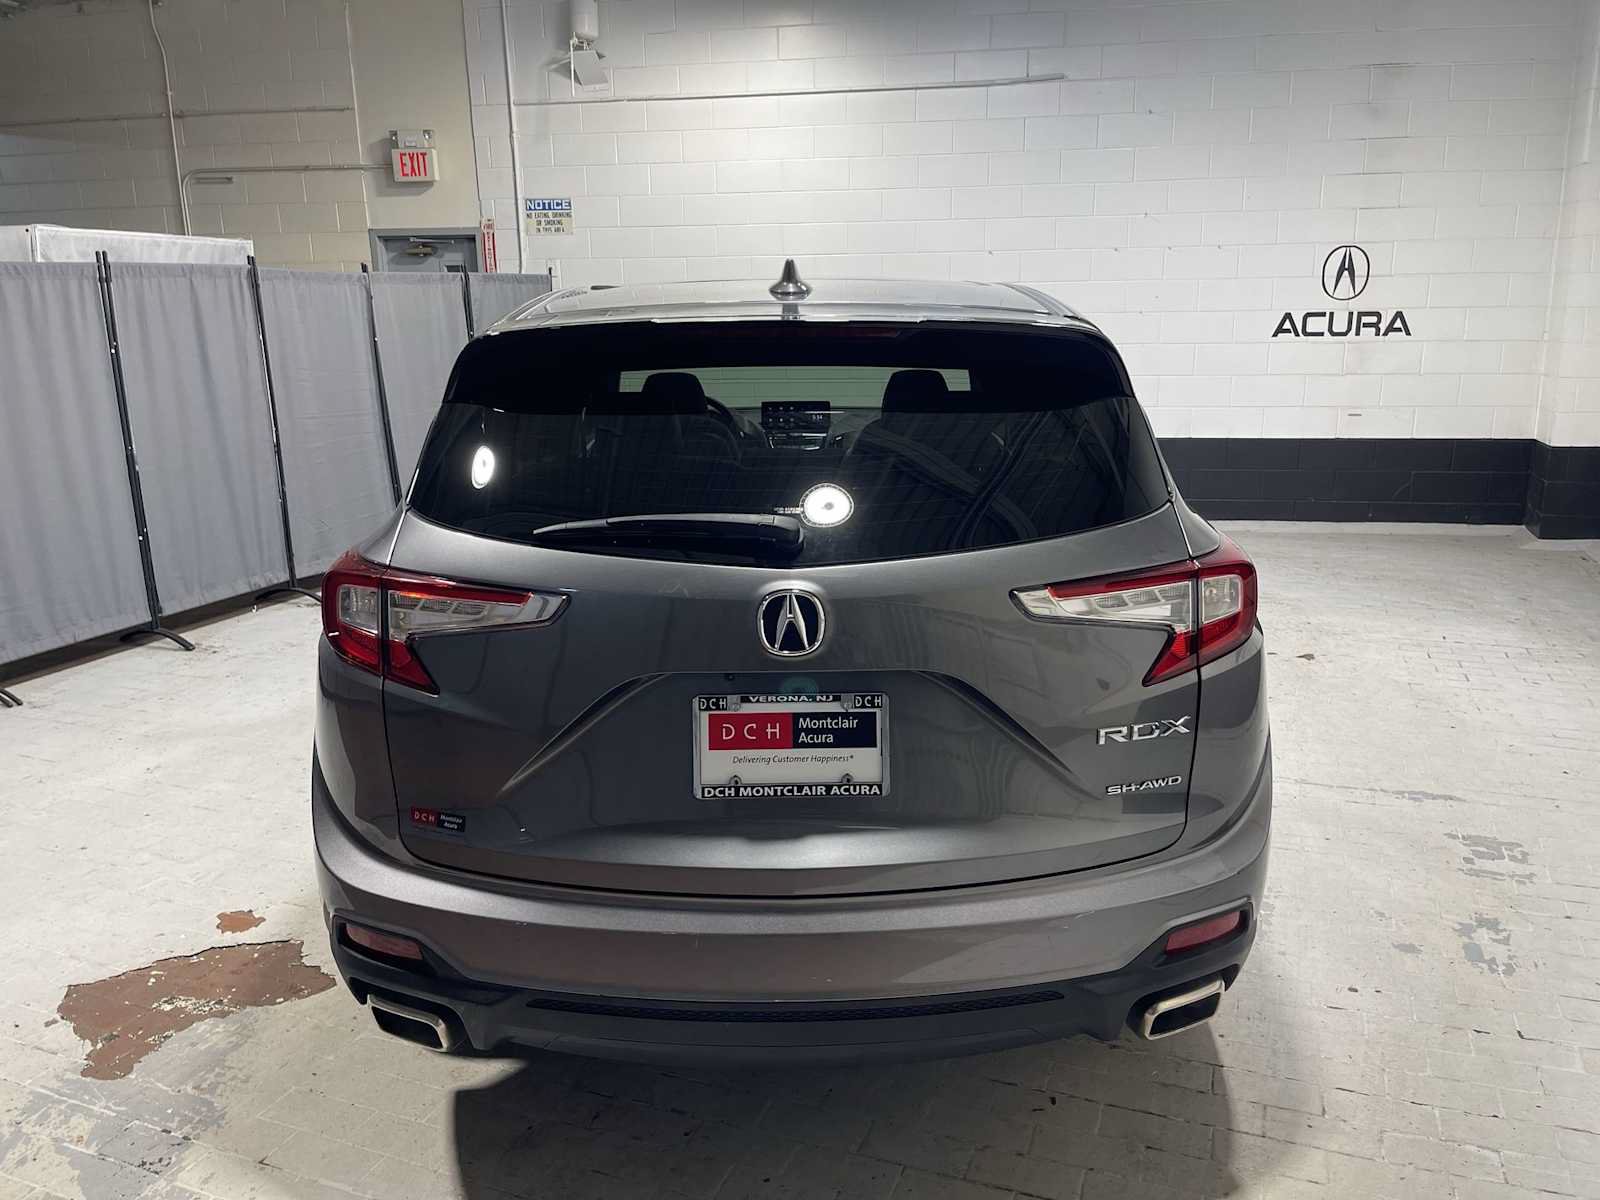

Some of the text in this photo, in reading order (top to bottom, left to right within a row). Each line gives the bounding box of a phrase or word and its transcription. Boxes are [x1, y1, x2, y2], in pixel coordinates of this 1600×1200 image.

[400, 152, 428, 177] EXIT
[526, 199, 571, 210] NOTICE
[1272, 310, 1412, 338] ACURA
[700, 698, 727, 709] DCH
[816, 695, 833, 703] NJ
[855, 695, 882, 707] DCH
[799, 716, 858, 729] Montclair
[722, 723, 780, 740] DCH
[1097, 716, 1191, 745] RDX
[799, 732, 834, 743] Acura
[732, 756, 771, 765] Delivering
[772, 755, 809, 764] Customer
[704, 784, 881, 797] DCH MONTCLAIR ACURA
[1106, 776, 1182, 795] SH-AWD
[414, 810, 435, 822] DCH
